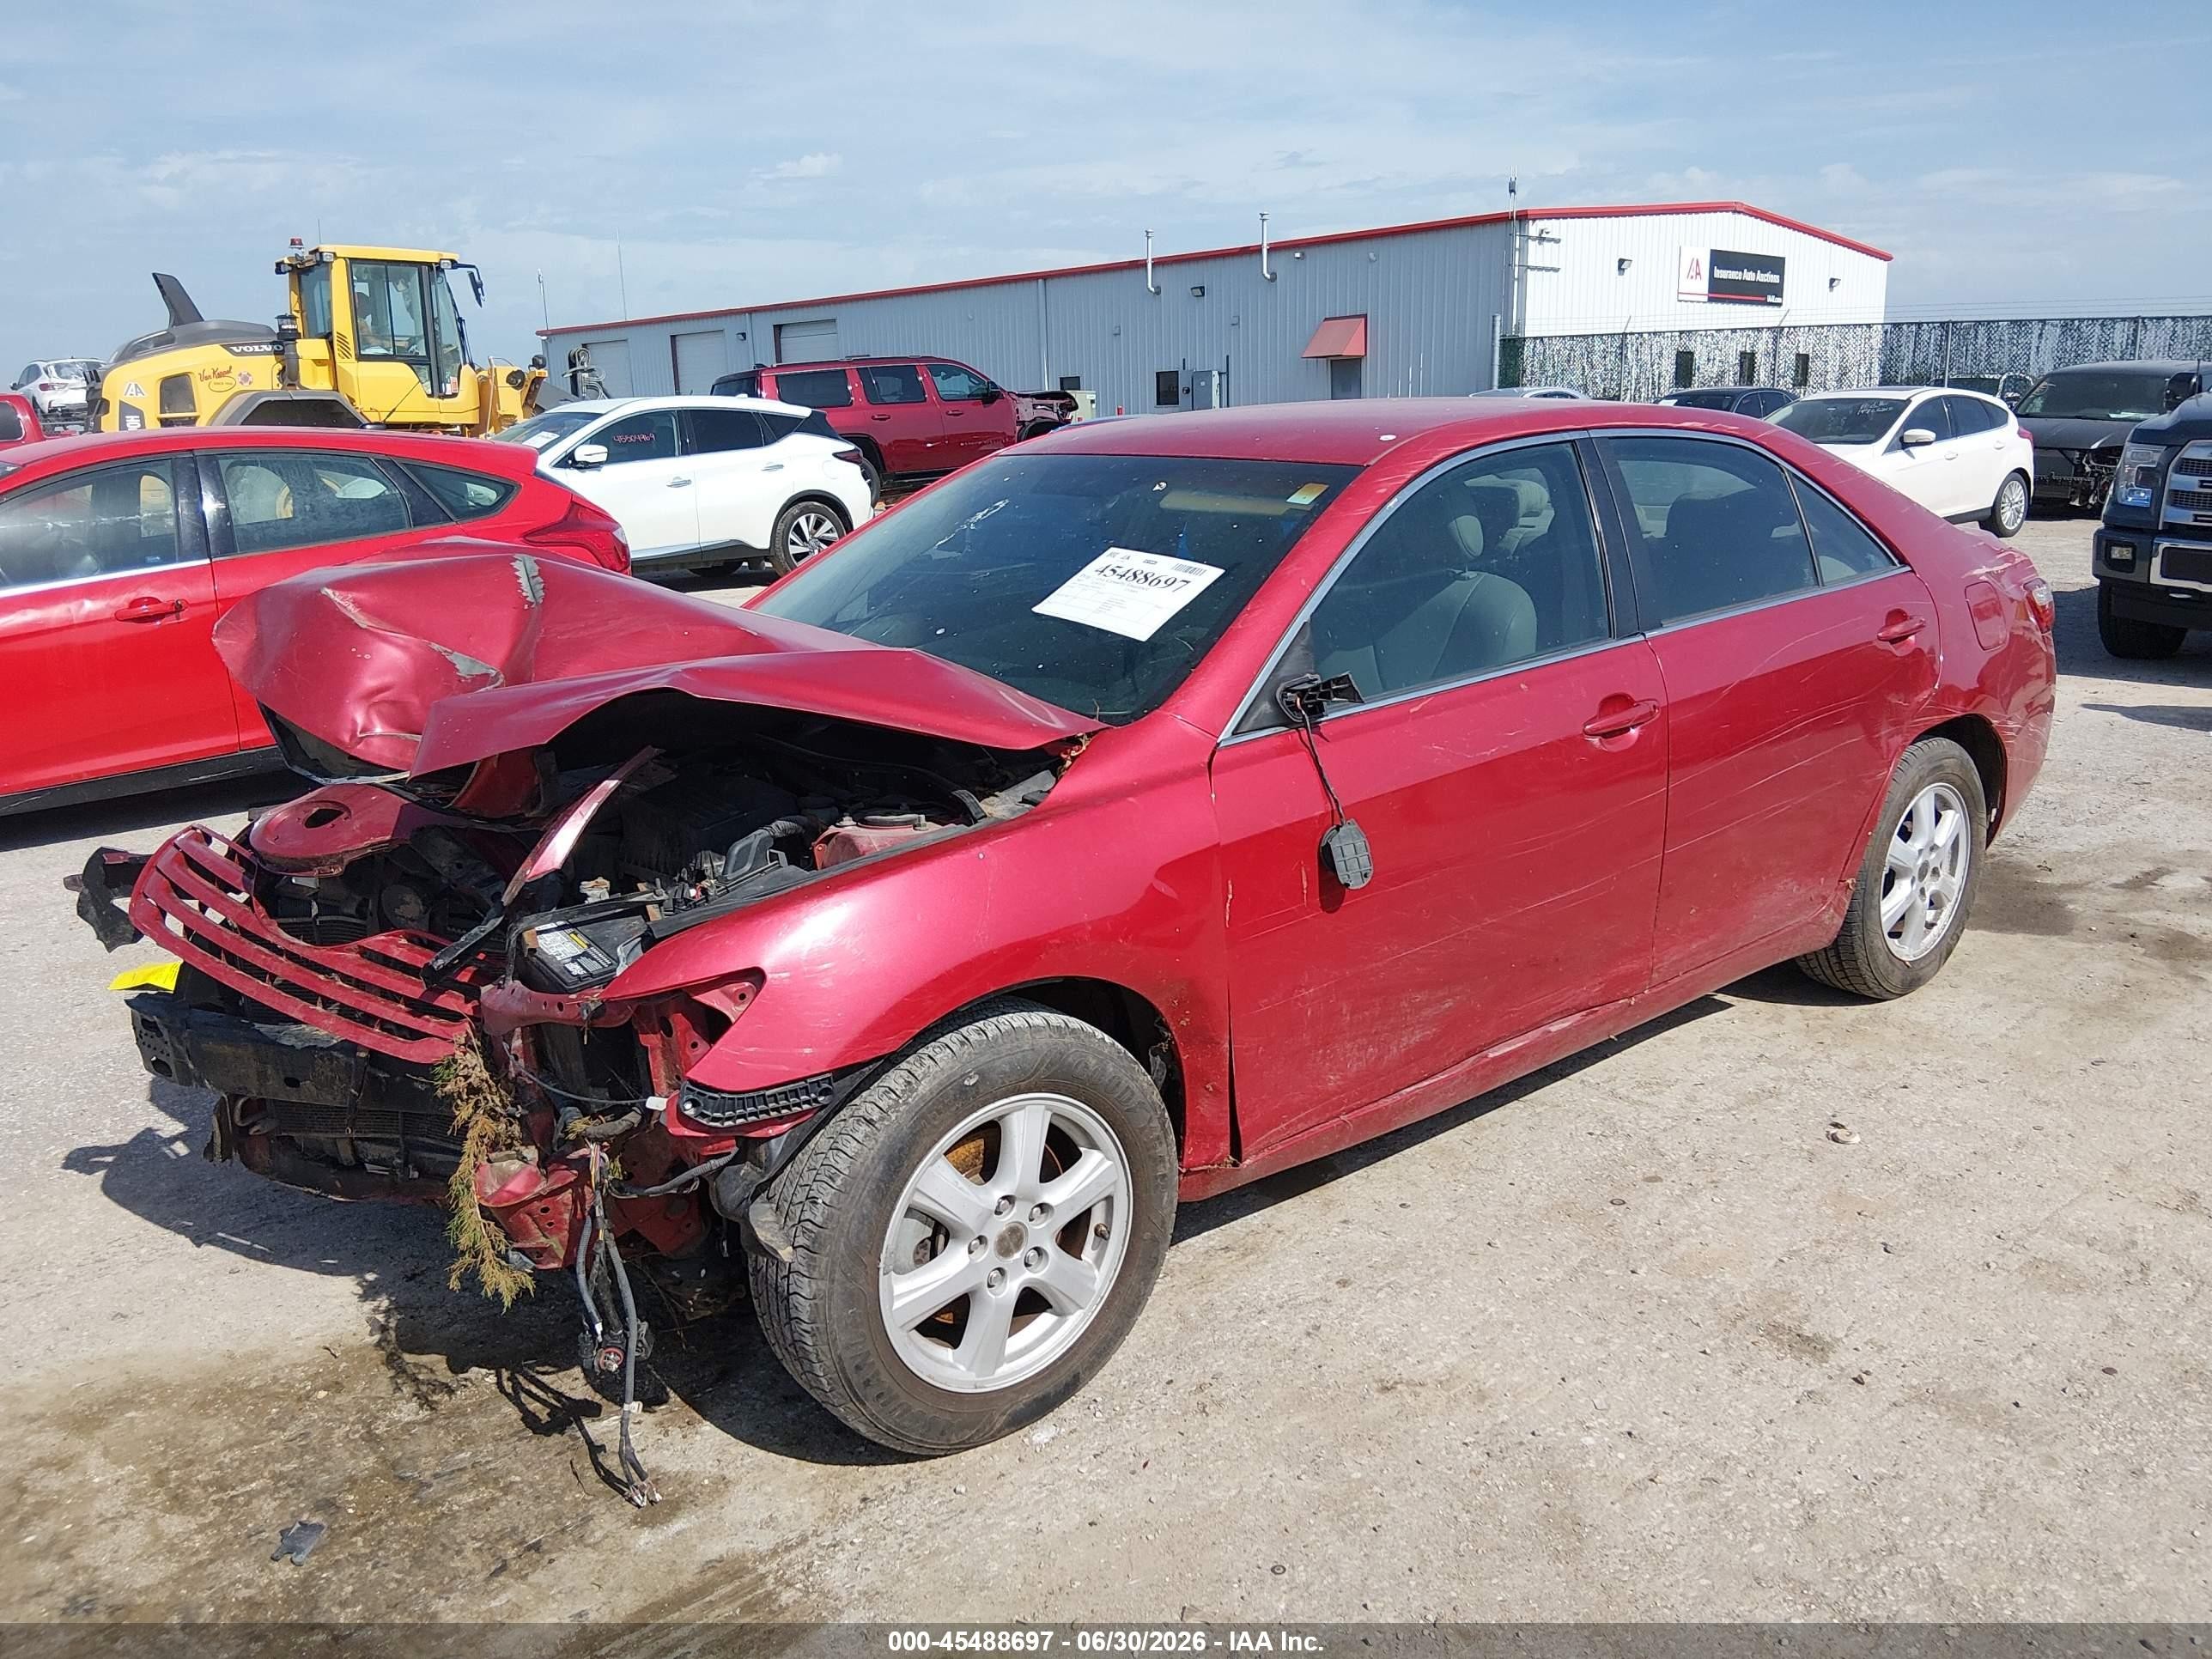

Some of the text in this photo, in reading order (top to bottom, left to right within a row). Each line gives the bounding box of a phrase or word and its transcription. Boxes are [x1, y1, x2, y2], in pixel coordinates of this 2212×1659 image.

[1714, 266, 1780, 283] Insurance Auto Auctions
[229, 344, 283, 353] VOLVO
[1095, 564, 1192, 592] 45488697
